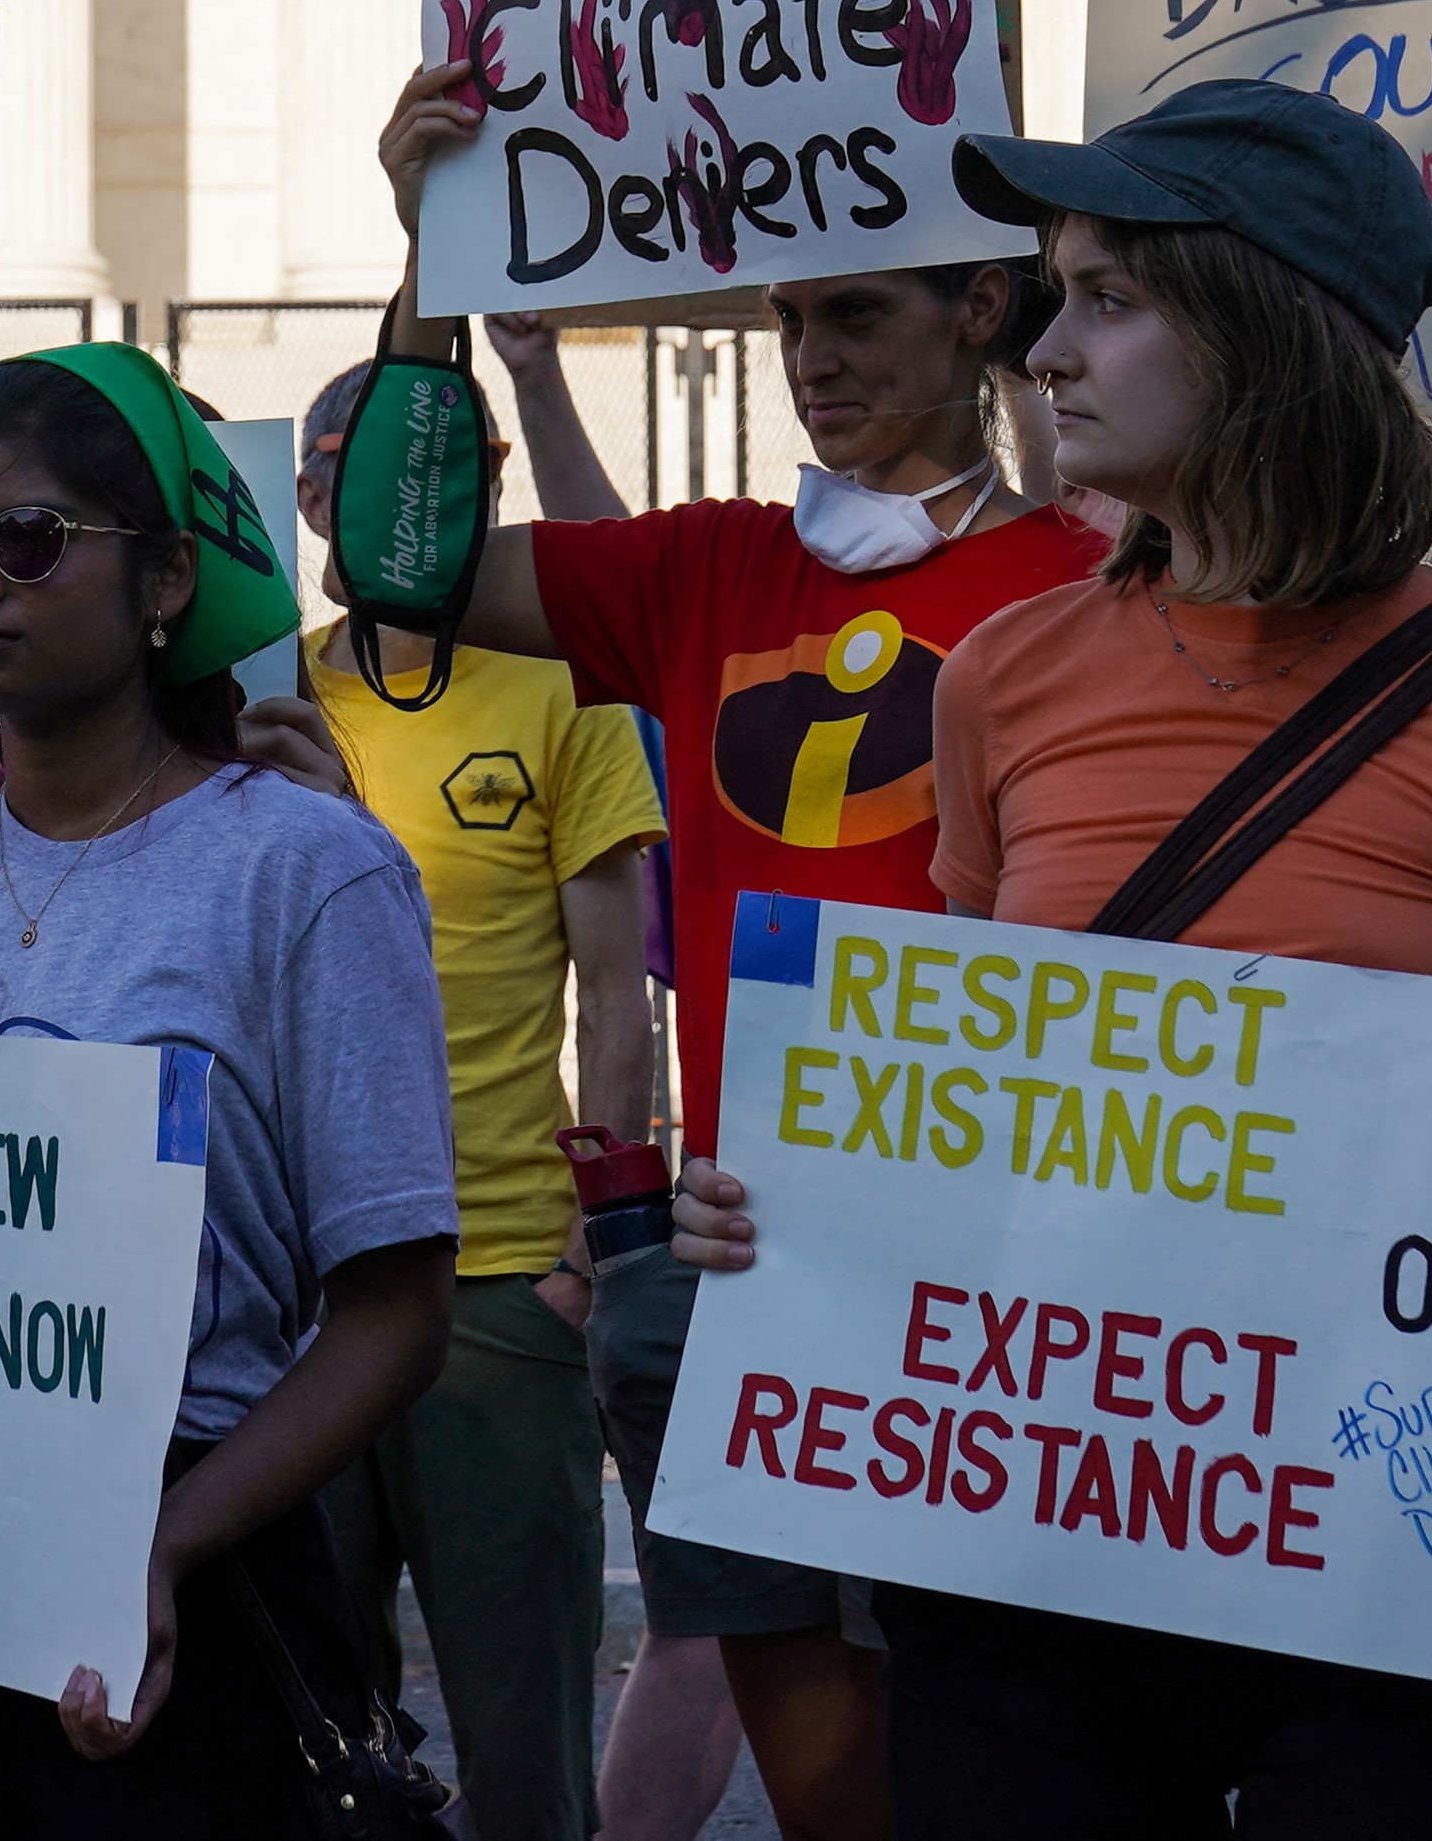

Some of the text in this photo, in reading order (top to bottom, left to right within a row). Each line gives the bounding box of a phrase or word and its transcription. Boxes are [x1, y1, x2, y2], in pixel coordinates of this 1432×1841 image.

[505, 126, 908, 284] Deniers
[424, 544, 438, 571] FOR
[828, 935, 1286, 1087] RESPECT
[778, 1046, 1297, 1216] EXISTANCE
[901, 1279, 1298, 1437] EXPECT
[724, 1372, 1335, 1571] RESISTANCE
